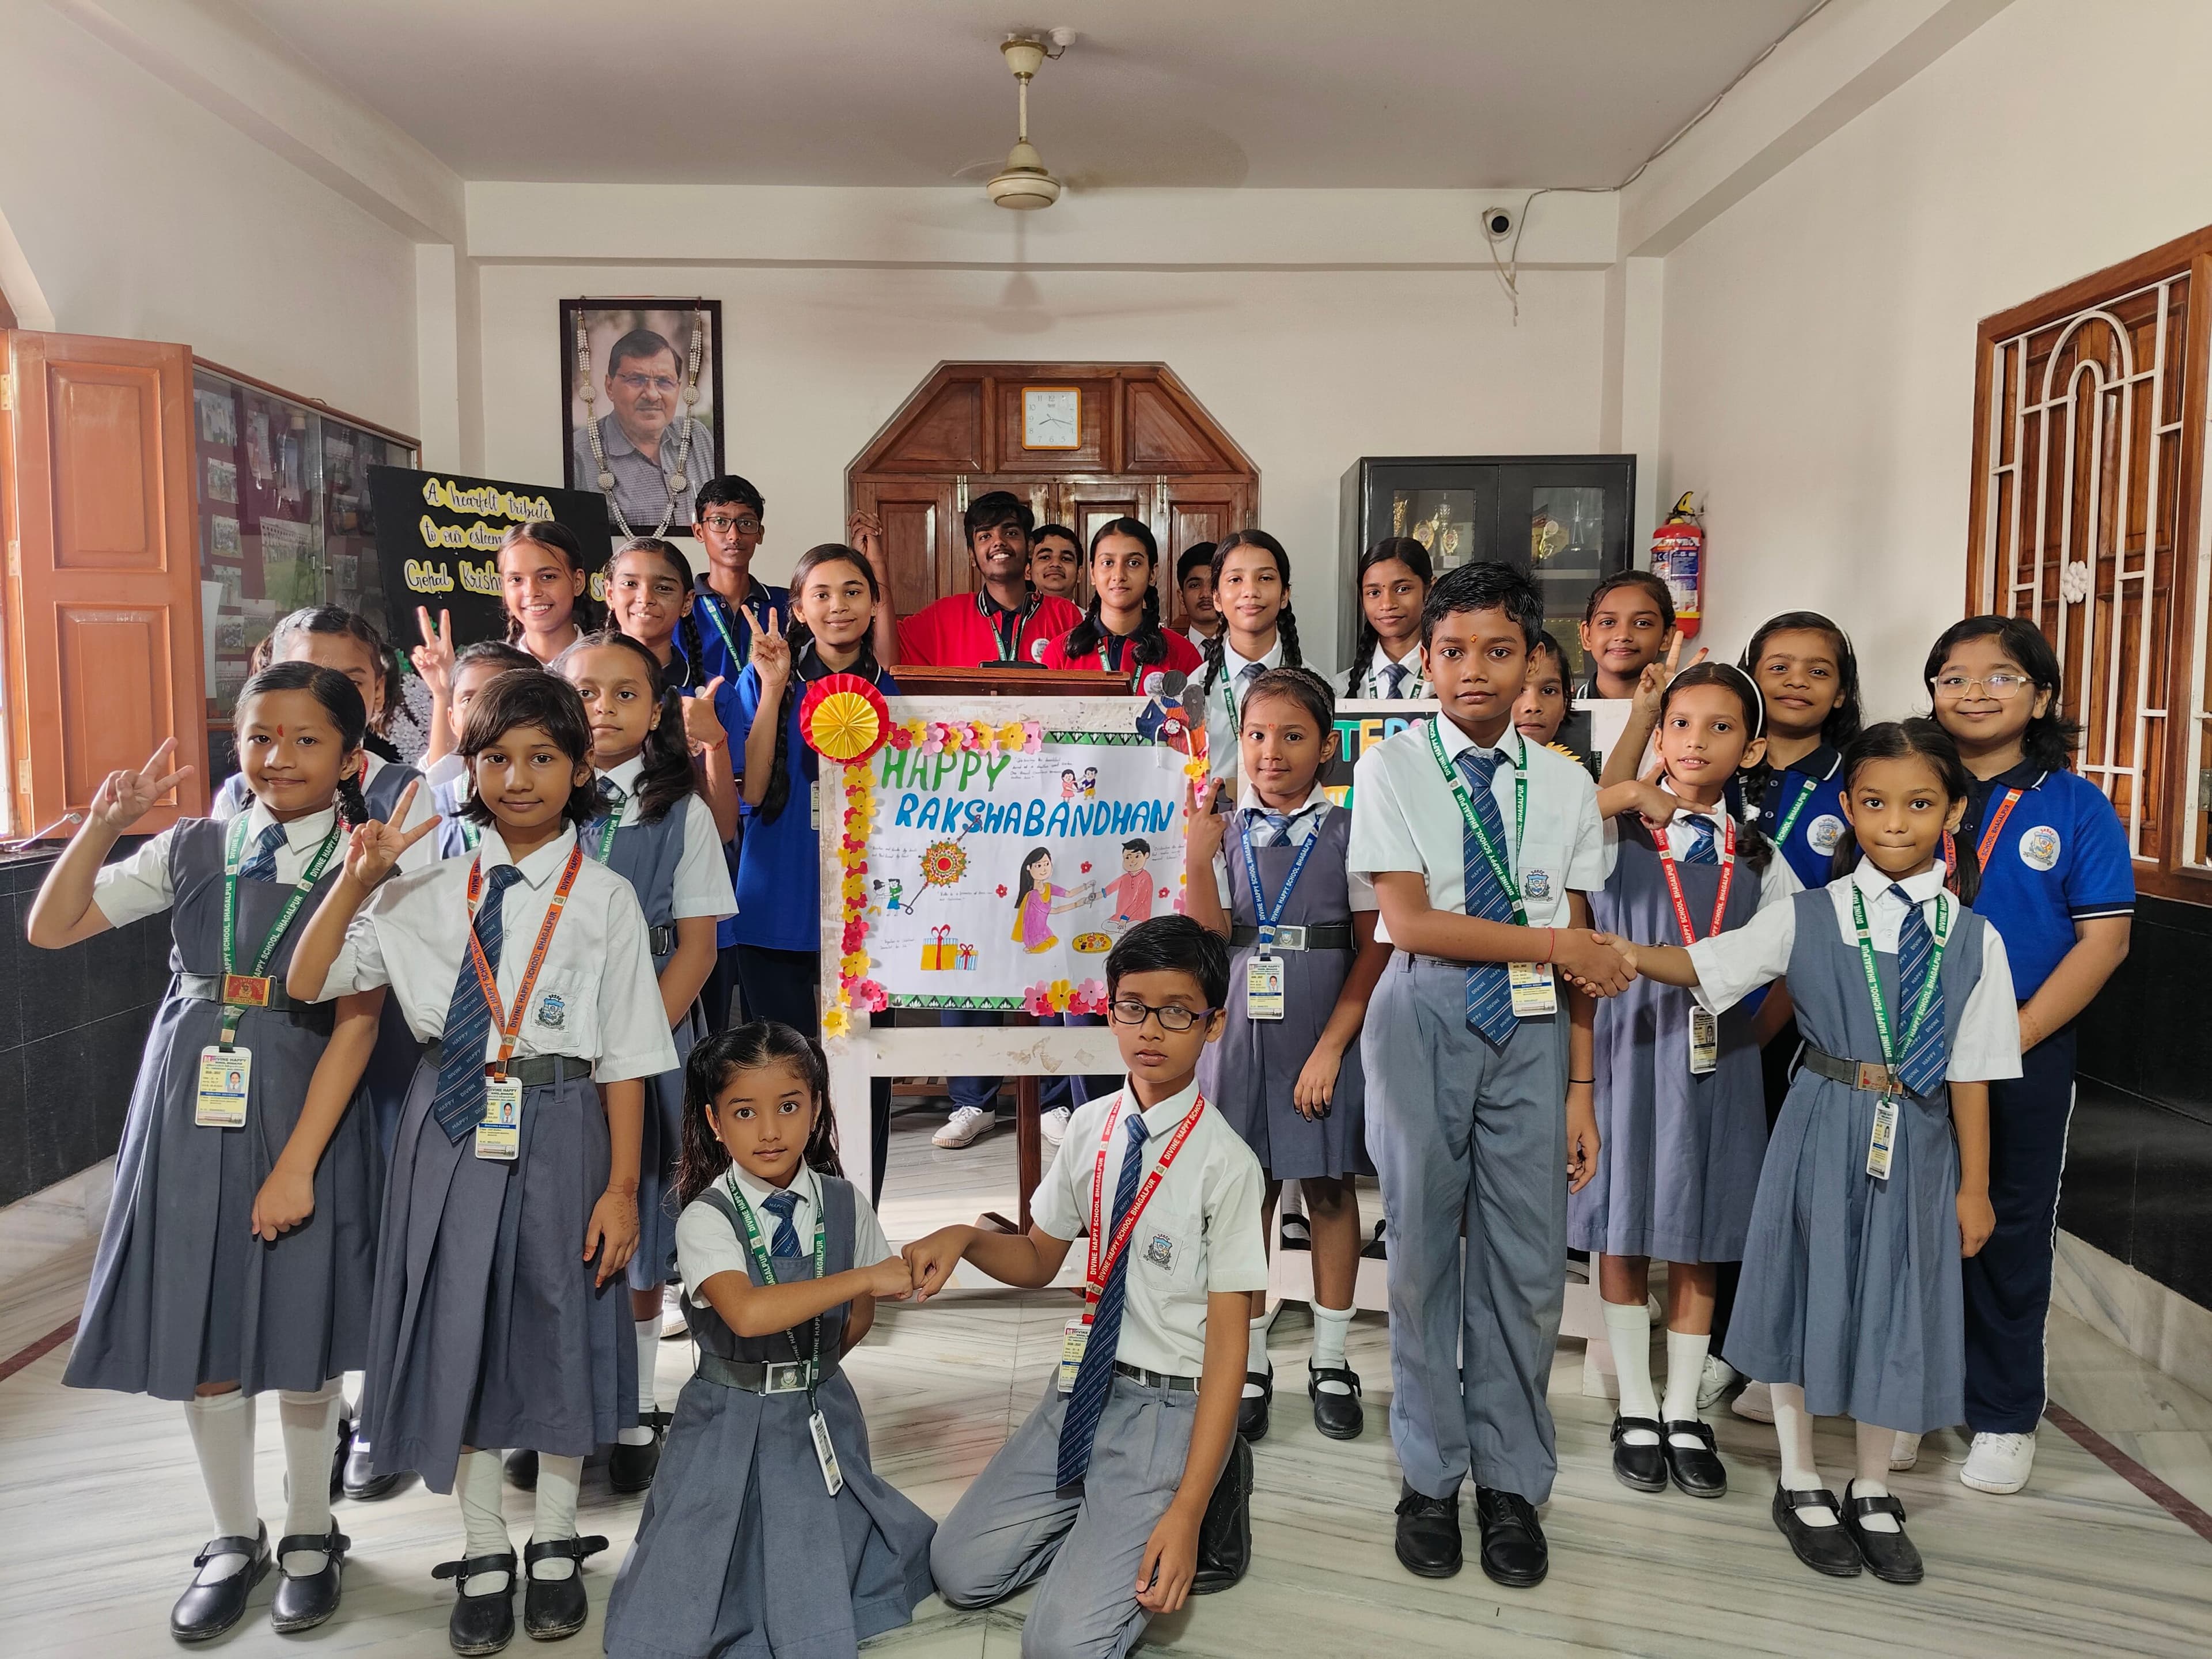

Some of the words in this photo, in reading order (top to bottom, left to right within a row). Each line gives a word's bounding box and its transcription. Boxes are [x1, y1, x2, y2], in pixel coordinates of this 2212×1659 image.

[426, 483, 439, 503] A
[507, 497, 551, 520] tribute
[424, 521, 437, 543] to
[444, 530, 463, 544] our
[407, 562, 449, 592] Gopal
[1431, 737, 1443, 756] HAPPY
[881, 747, 1012, 792] HAPPY
[1439, 754, 1451, 777] DIVINE
[895, 793, 1175, 837] RAKSHABANDHAN
[1456, 792, 1479, 830] BHAGALPUR
[1479, 800, 1493, 813] HAPPY
[1787, 792, 1808, 820] BHAGALPUR
[1991, 804, 2010, 834] BHAGALPUR
[603, 819, 619, 854] BHAGALPUR
[229, 838, 239, 859] DIVINE
[310, 856, 326, 878] DIVINE
[323, 840, 335, 859] HAPPY
[1243, 833, 1254, 864] BHAGALPUR
[1470, 865, 1485, 880] HAPPY
[1488, 854, 1504, 876] HAPPY
[471, 877, 482, 895] DIVINE
[560, 869, 574, 891] DIVINE
[1270, 902, 1282, 922] DIVINE
[1278, 887, 1290, 904] HAPPY
[1297, 837, 1314, 866] BHAGALPUR
[1483, 882, 1498, 896] HAPPY
[1499, 874, 1515, 897] DIVINE
[1665, 863, 1680, 899] BHAGALPUR
[1721, 866, 1731, 901] BHAGALPUR
[224, 881, 232, 922] BHAGALPUR
[1467, 899, 1481, 914] DIVINE
[275, 895, 304, 934] BHAGALPUR
[1855, 903, 1864, 925] DIVINE
[1938, 912, 1948, 932] DIVINE
[480, 923, 497, 939] DIVINE
[1681, 923, 1692, 944] HAPPY
[1910, 935, 1924, 950] DIVINE
[510, 1002, 523, 1028] DIVINE
[518, 980, 531, 1004] HAPPY
[537, 911, 558, 951] BHAGALPUR
[1862, 944, 1877, 983] BHAGALPUR
[1911, 968, 1925, 984] HAPPY
[487, 980, 497, 1003] HAPPY
[1471, 981, 1486, 995] DIVINE
[1910, 1015, 1922, 1039] HAPPY
[1926, 950, 1942, 988] BHAGALPUR
[462, 996, 479, 1012] DIVINE
[1486, 998, 1501, 1012] DIVINE
[474, 1013, 490, 1030] DIVINE
[1877, 1012, 1888, 1036] HAPPY
[1925, 1018, 1940, 1033] DIVINE
[452, 1031, 469, 1047] HAPPY
[1881, 1035, 1893, 1058] DIVINE
[465, 1048, 481, 1063] HAPPY
[1922, 1051, 1936, 1066] HAPPY
[447, 1065, 463, 1080] DIVINE
[1905, 1067, 1920, 1082] DIVINE
[460, 1083, 476, 1097] DIVINE
[437, 1098, 455, 1113] HAPPY
[452, 1116, 469, 1130] HAPPY
[1105, 1113, 1116, 1136] DIVINE
[1163, 1138, 1181, 1161] DIVINE
[1177, 1120, 1194, 1141] HAPPY
[733, 1192, 747, 1214] HAPPY
[741, 1208, 756, 1233] DIVINE
[1090, 1252, 1098, 1275] DIVINE
[1095, 1157, 1104, 1198] BHAGALPUR
[1098, 1259, 1111, 1281] DIVINE
[1107, 1239, 1120, 1262] HAPPY
[1130, 1178, 1157, 1216] BHAGALPUR
[784, 1237, 796, 1254] HAPPY
[791, 1344, 803, 1367] DIVINE
